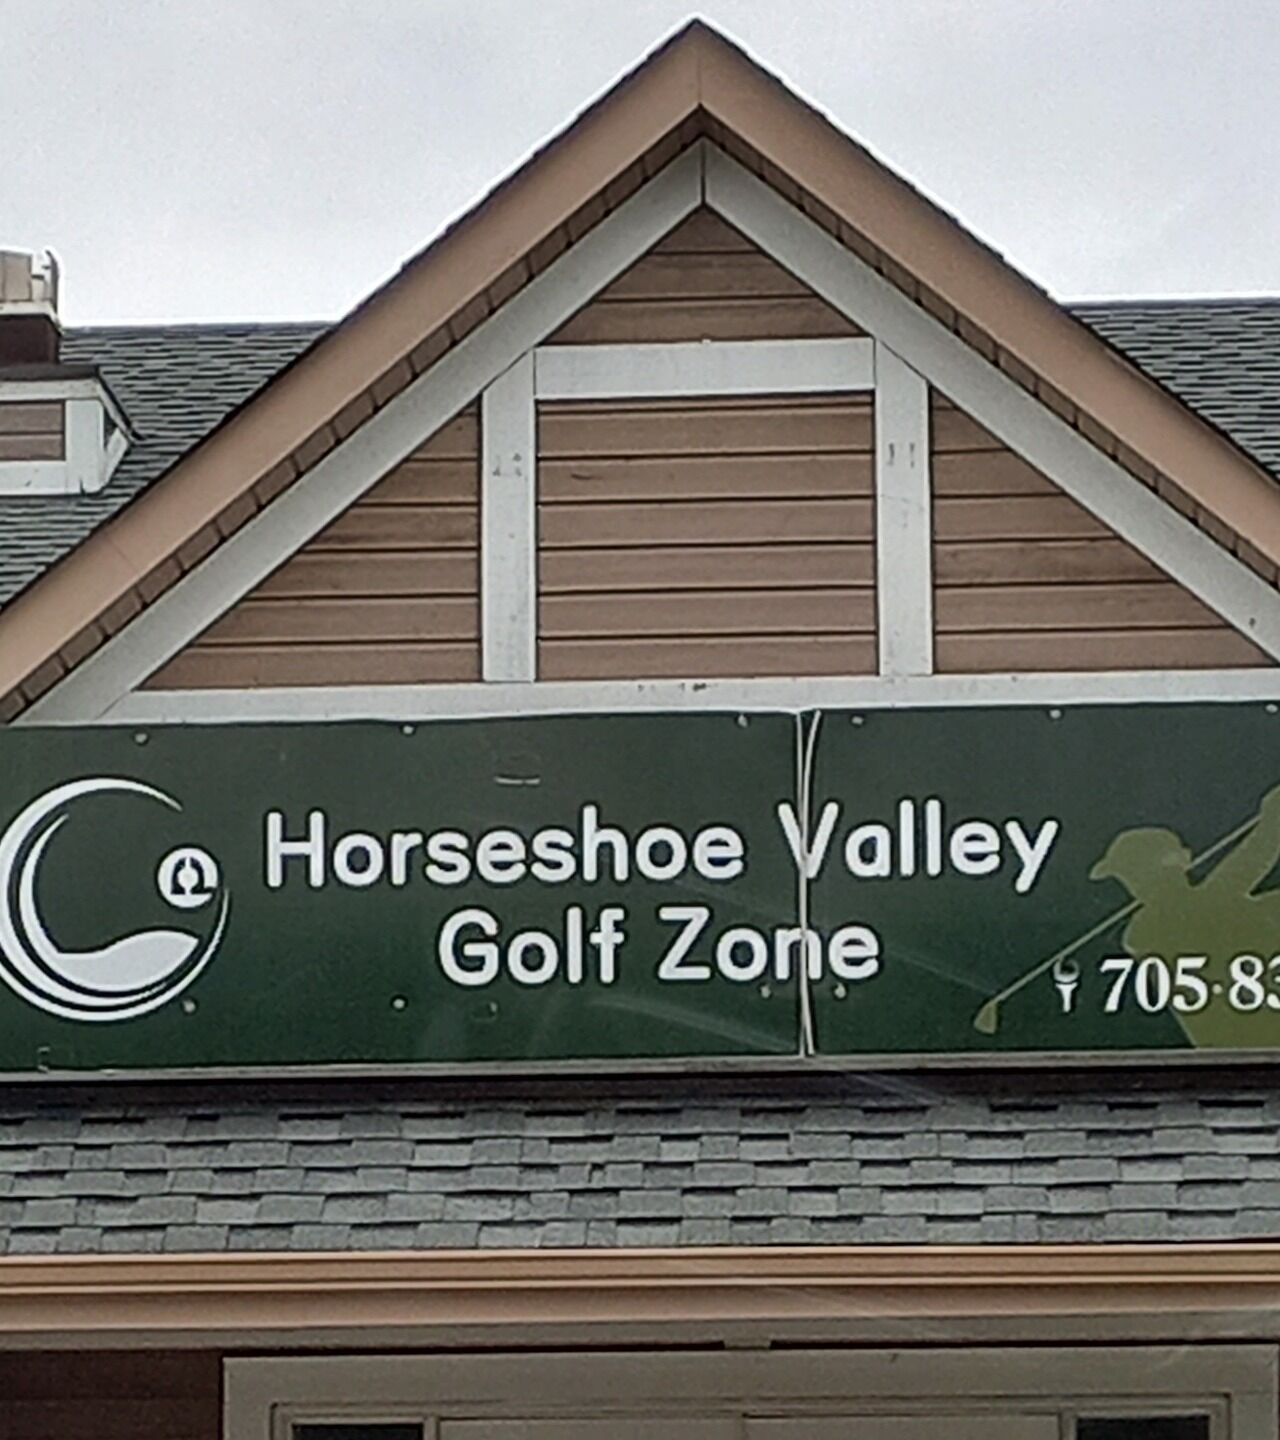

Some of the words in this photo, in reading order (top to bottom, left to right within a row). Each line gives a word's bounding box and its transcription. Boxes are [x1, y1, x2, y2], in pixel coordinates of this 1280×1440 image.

[265, 804, 746, 888] Horseshoe
[777, 799, 1059, 894] Valley
[438, 905, 626, 987] Golf
[657, 904, 880, 982] Zone
